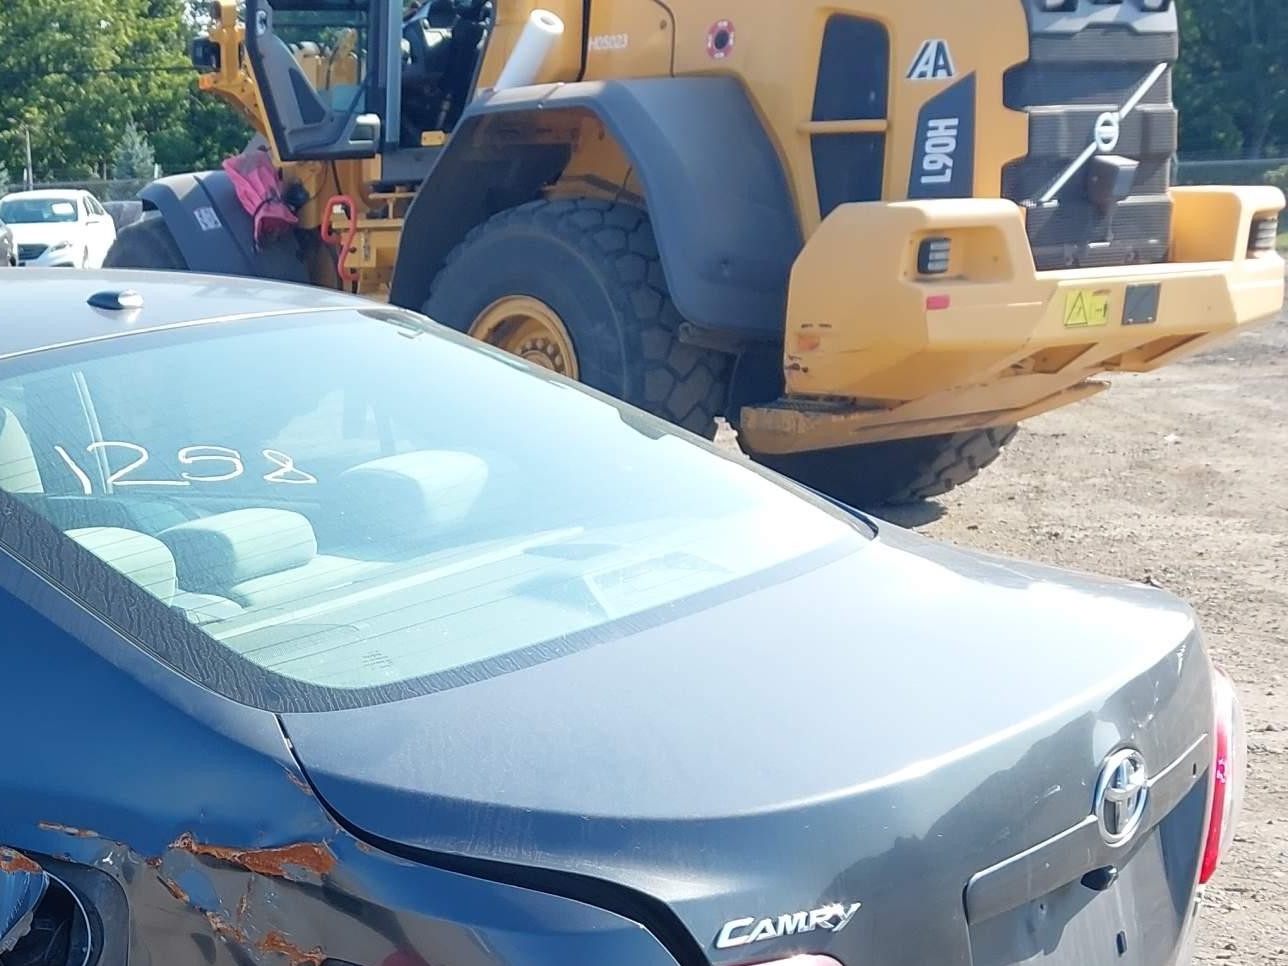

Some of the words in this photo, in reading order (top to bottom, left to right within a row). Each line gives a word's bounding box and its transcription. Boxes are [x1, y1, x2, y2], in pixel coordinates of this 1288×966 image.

[920, 117, 959, 184] L90H
[54, 440, 318, 495] 1258
[715, 902, 862, 949] CAMRY
